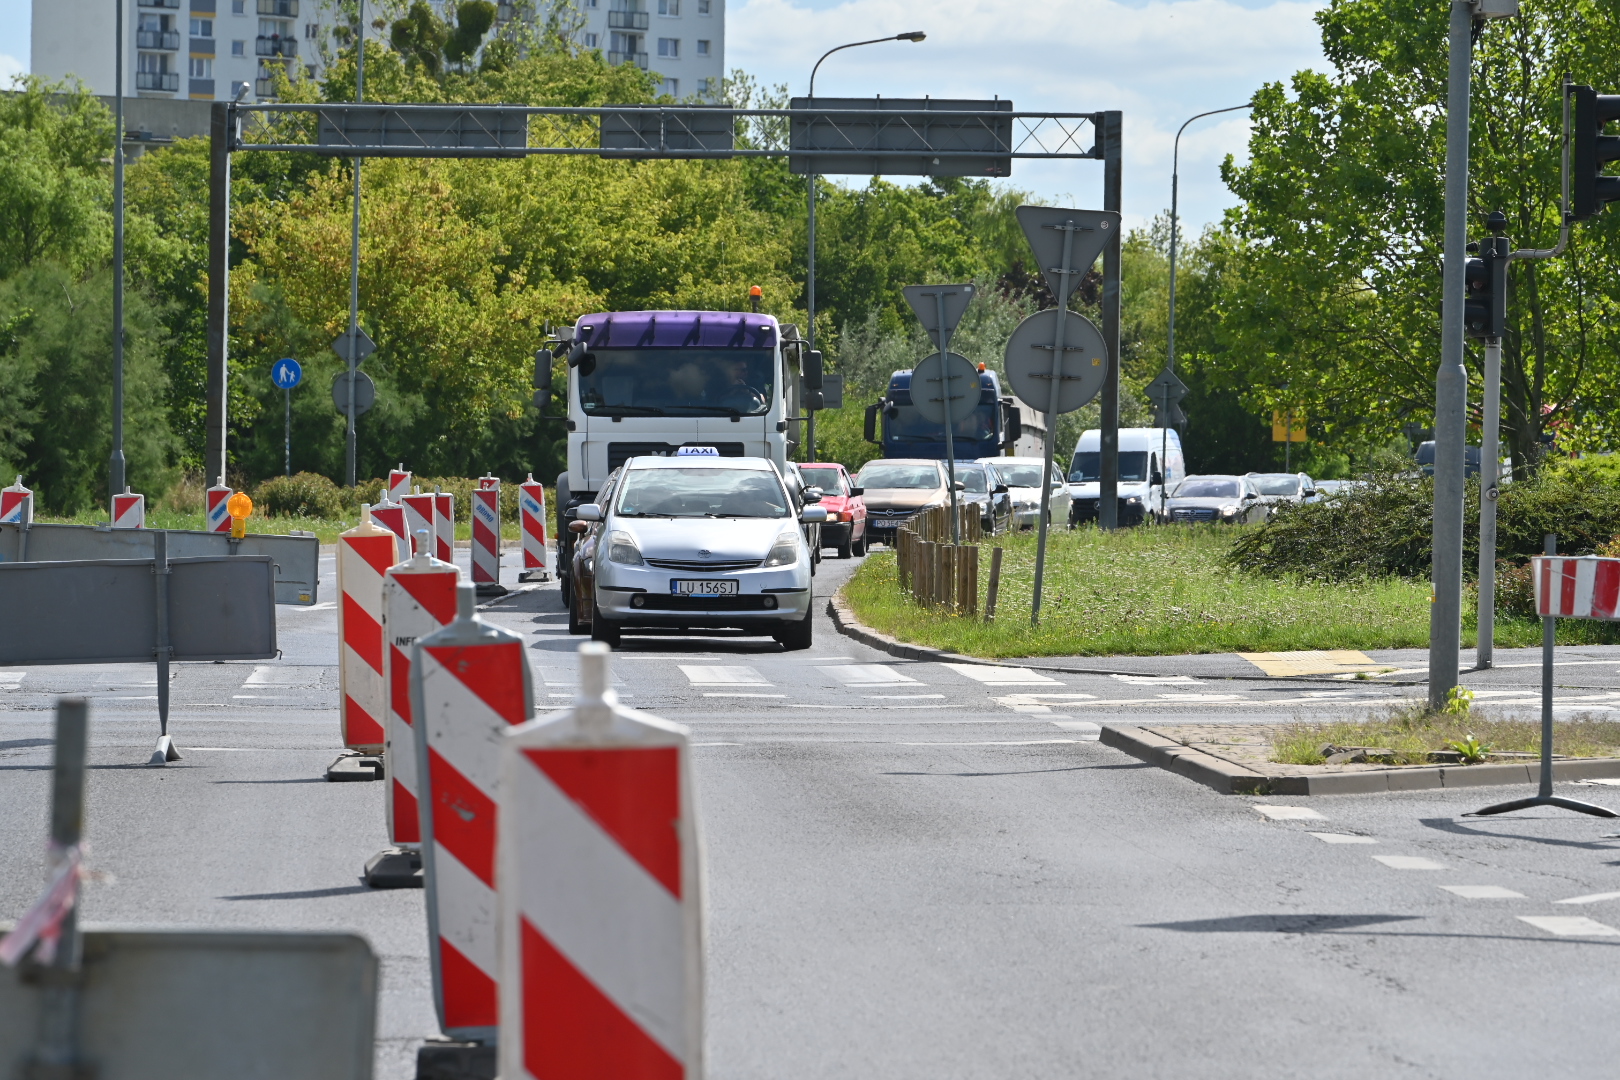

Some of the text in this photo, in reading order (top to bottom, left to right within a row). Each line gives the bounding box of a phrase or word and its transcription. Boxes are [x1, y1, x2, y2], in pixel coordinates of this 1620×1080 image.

[476, 504, 494, 522] DROMO
[680, 581, 733, 594] LU 156SJ
